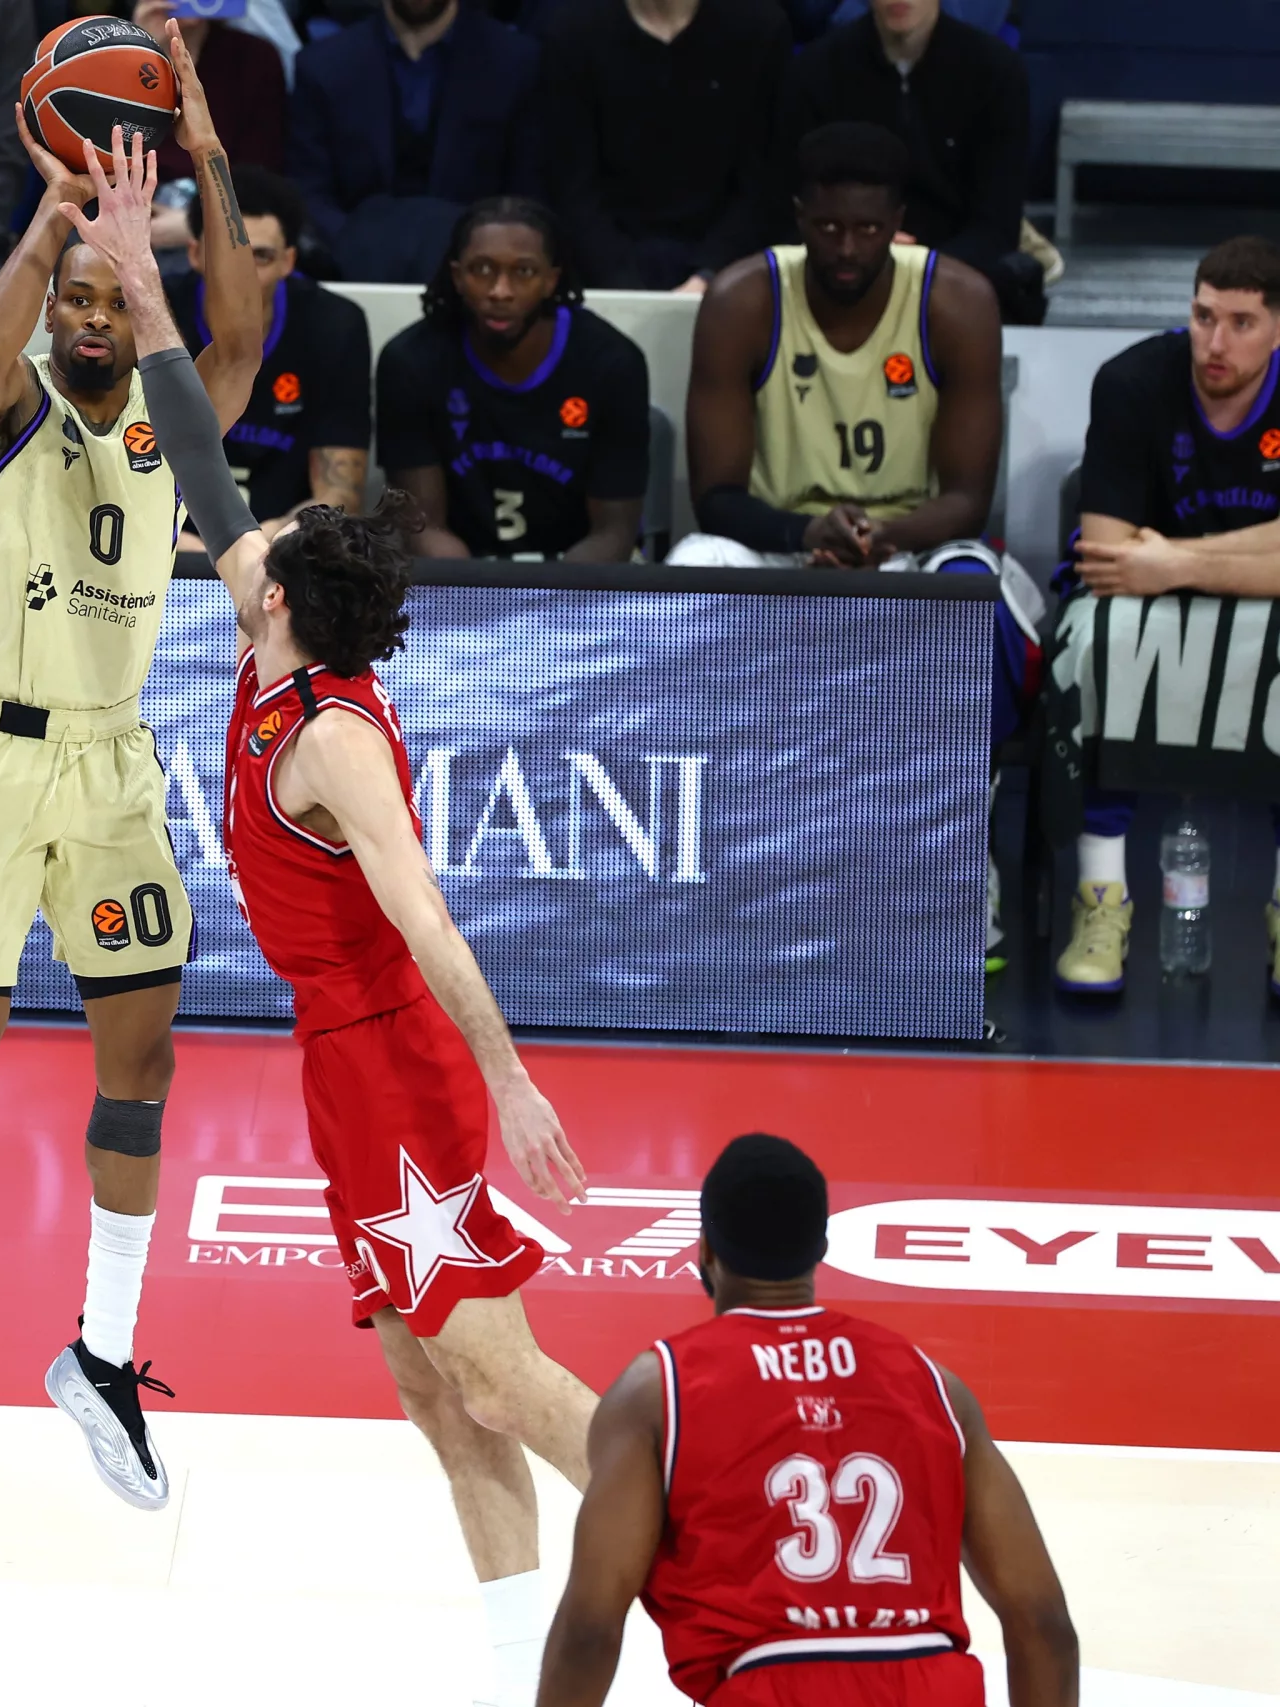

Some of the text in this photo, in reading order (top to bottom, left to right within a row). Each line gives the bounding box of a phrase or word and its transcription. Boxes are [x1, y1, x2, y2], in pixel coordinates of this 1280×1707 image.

[835, 418, 885, 475] 19
[90, 503, 125, 565] 0
[493, 487, 527, 541] 3
[66, 597, 138, 628] Sanitària
[1103, 595, 1280, 757] WI
[163, 741, 708, 884] AMANI
[130, 882, 174, 947] 0
[186, 1244, 345, 1269] EMPO
[537, 1256, 702, 1280] ARMA
[751, 1336, 857, 1382] NEBO
[764, 1451, 912, 1585] 32
